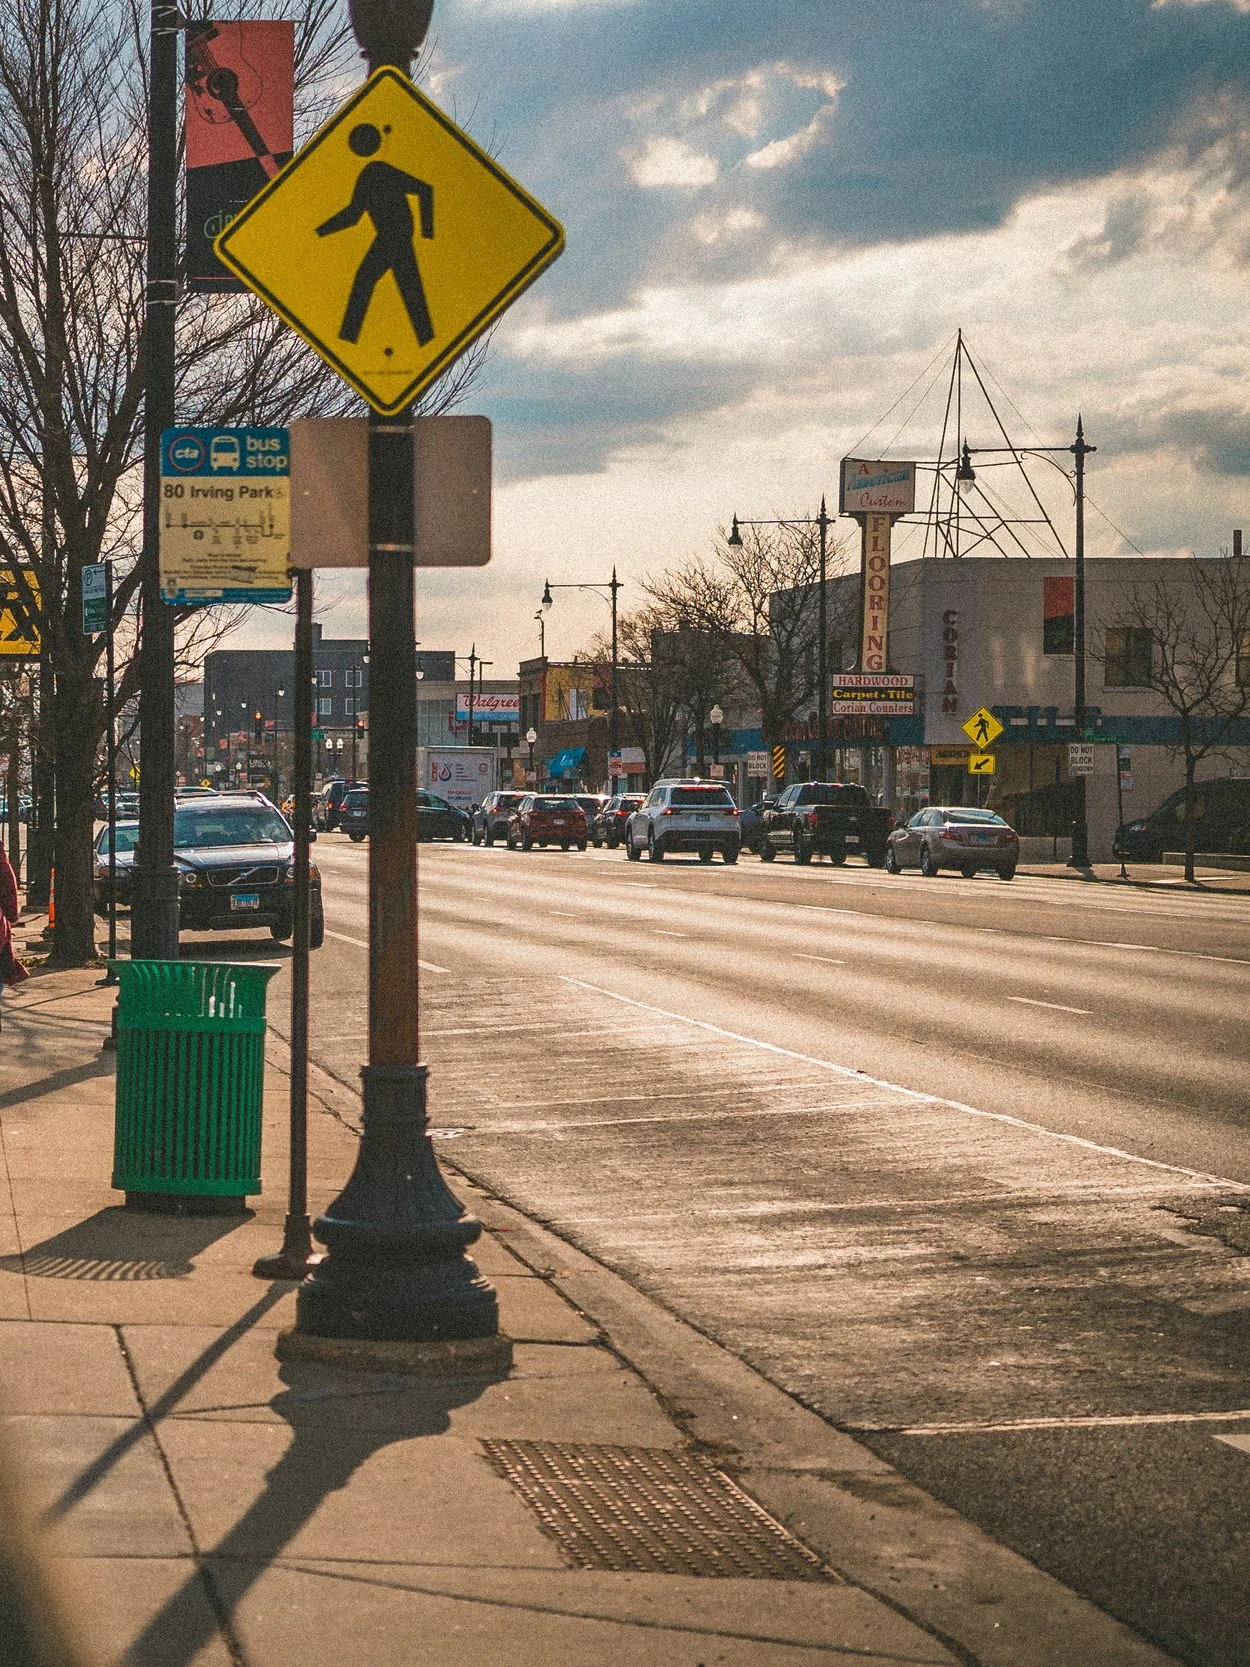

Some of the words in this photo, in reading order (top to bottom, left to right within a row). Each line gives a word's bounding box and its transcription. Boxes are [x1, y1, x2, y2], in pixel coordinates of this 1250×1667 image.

[246, 435, 281, 452] bus
[246, 453, 288, 472] stop
[163, 483, 185, 499] 80
[190, 485, 235, 502] Irving
[238, 484, 274, 499] Park
[860, 492, 908, 508] Custom
[865, 516, 887, 671] FLOORING
[838, 676, 908, 686] HARDWOOD
[463, 694, 521, 711] Walgree
[832, 689, 879, 700] Carpet
[833, 702, 867, 713] Corian
[869, 701, 913, 713] Counters
[1070, 746, 1080, 754] DO
[1080, 746, 1093, 754] NOT
[1070, 756, 1093, 764] BLOCK
